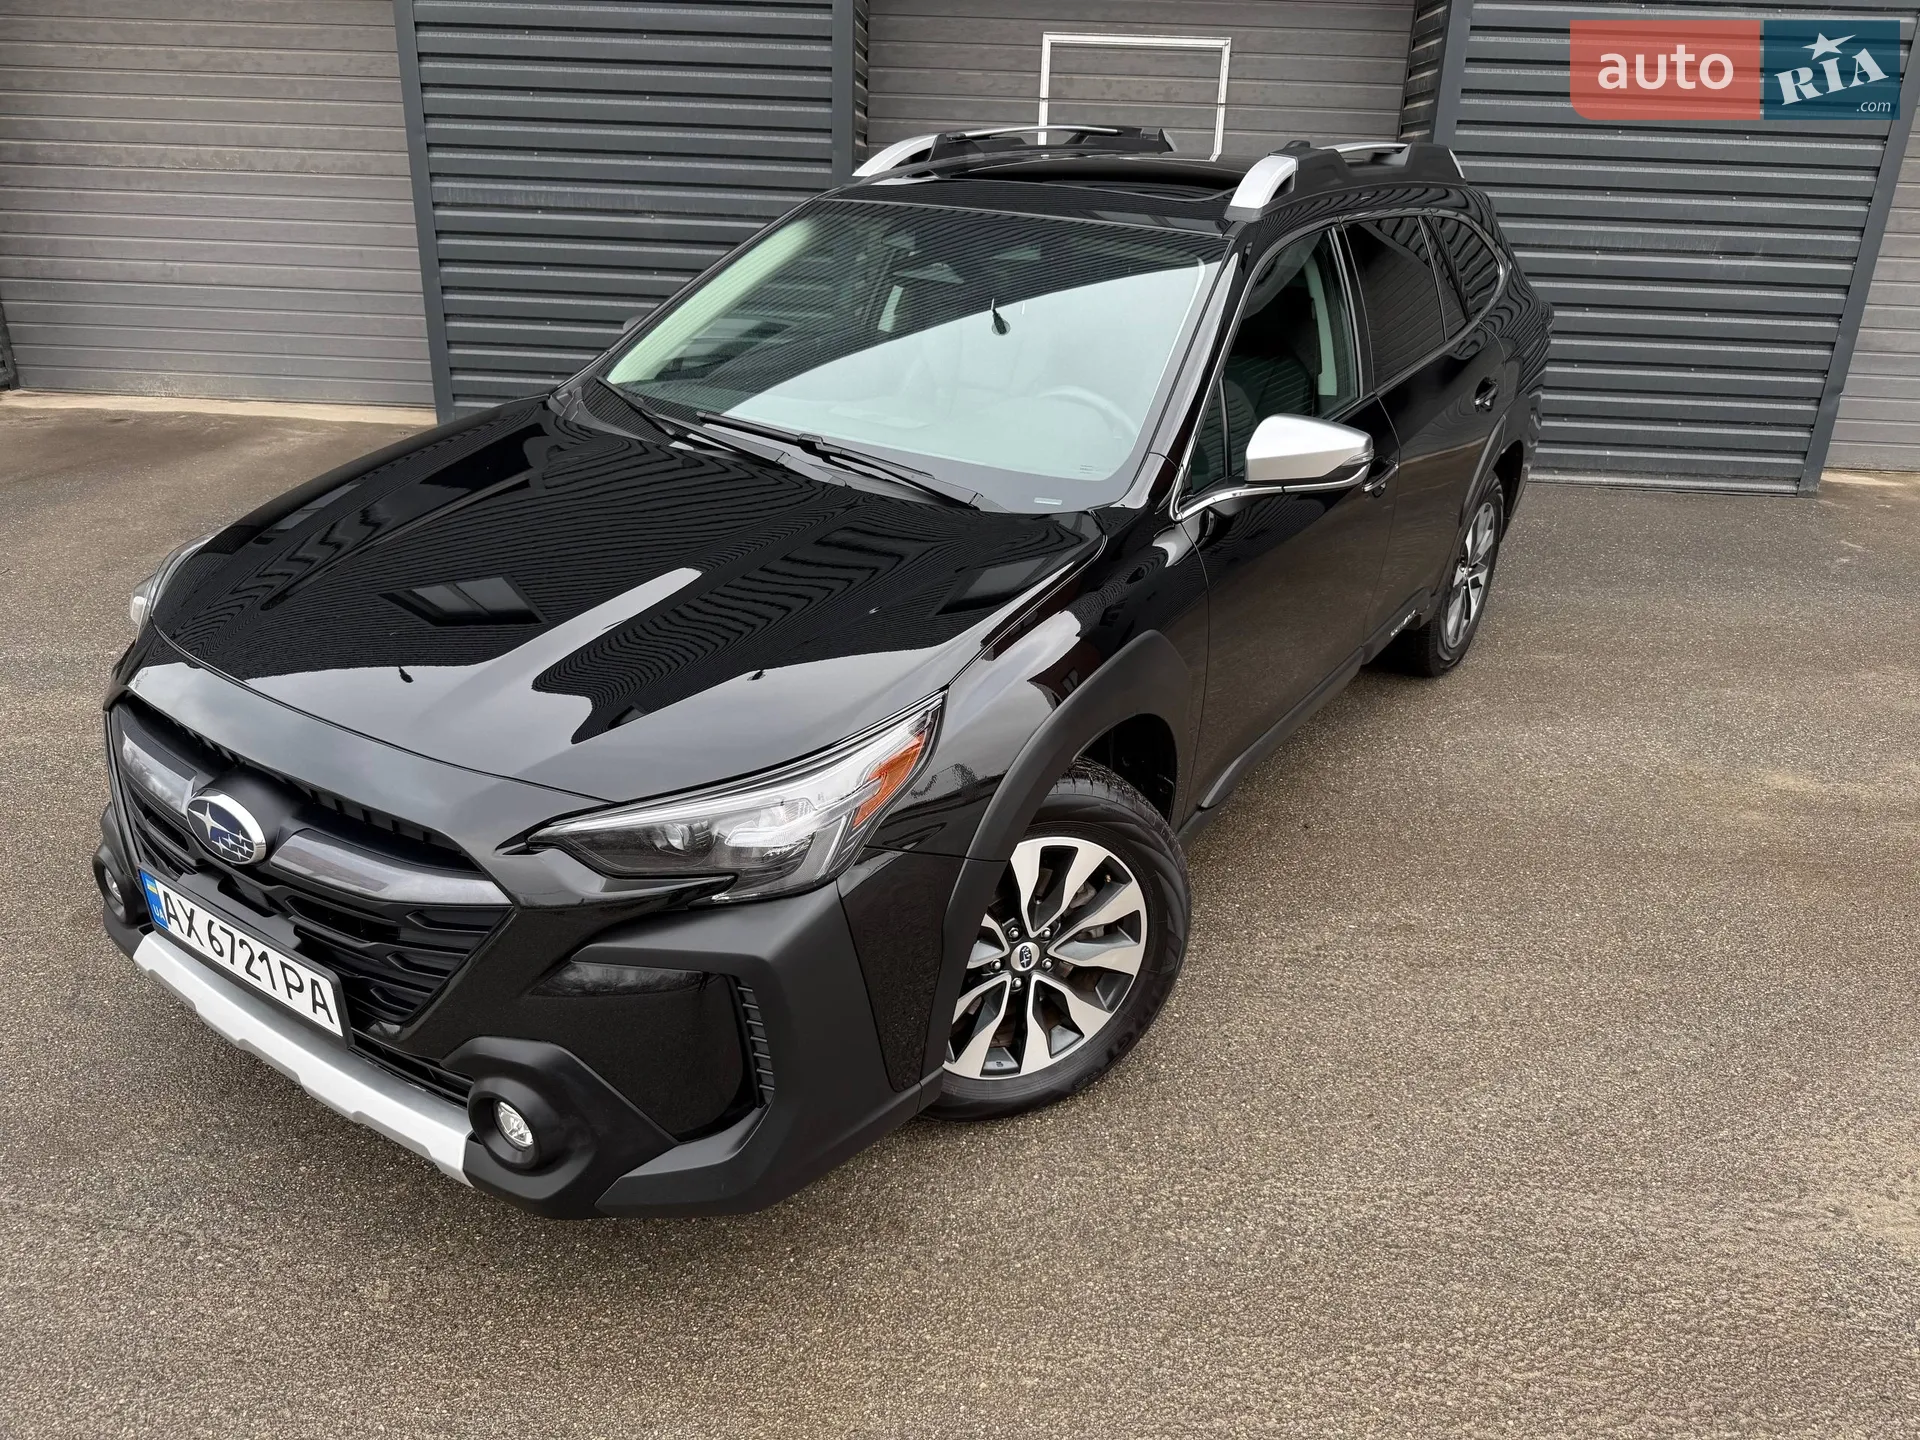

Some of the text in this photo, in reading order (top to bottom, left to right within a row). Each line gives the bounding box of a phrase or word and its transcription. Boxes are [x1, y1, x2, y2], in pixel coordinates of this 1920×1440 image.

[152, 905, 166, 921] UA
[163, 890, 335, 1025] AX 6721 PA
